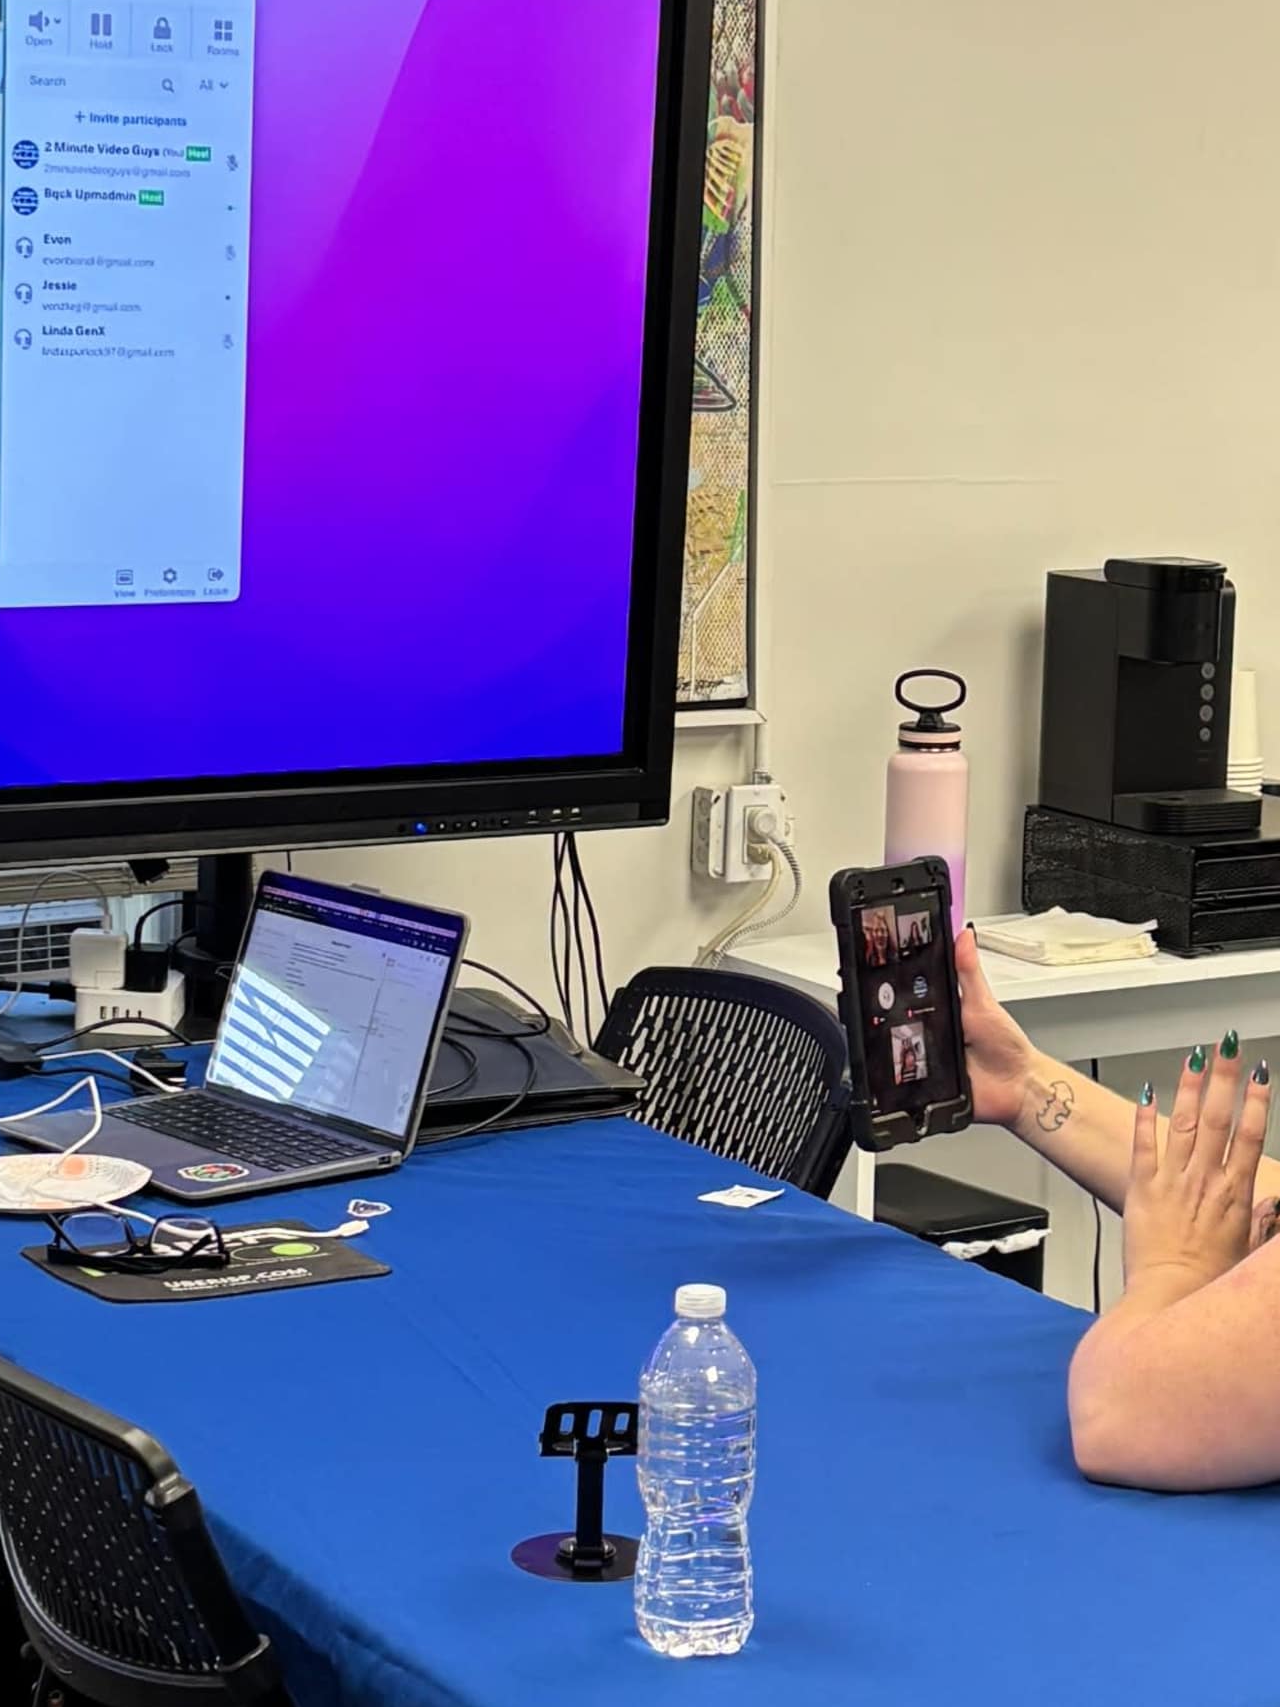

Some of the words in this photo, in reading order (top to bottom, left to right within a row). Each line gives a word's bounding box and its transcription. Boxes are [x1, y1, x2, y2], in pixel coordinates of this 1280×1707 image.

[25, 35, 53, 47] Open
[90, 38, 113, 50] Hold
[29, 75, 66, 87] Search
[199, 79, 214, 91] All
[89, 112, 120, 124] Invite
[122, 114, 187, 128] participants
[44, 141, 52, 152] 2
[54, 141, 95, 154] Minute
[97, 143, 130, 155] Video
[132, 145, 160, 158] Guys
[43, 233, 72, 245] Evon
[41, 280, 77, 291] Jessie
[41, 325, 73, 336] Linda
